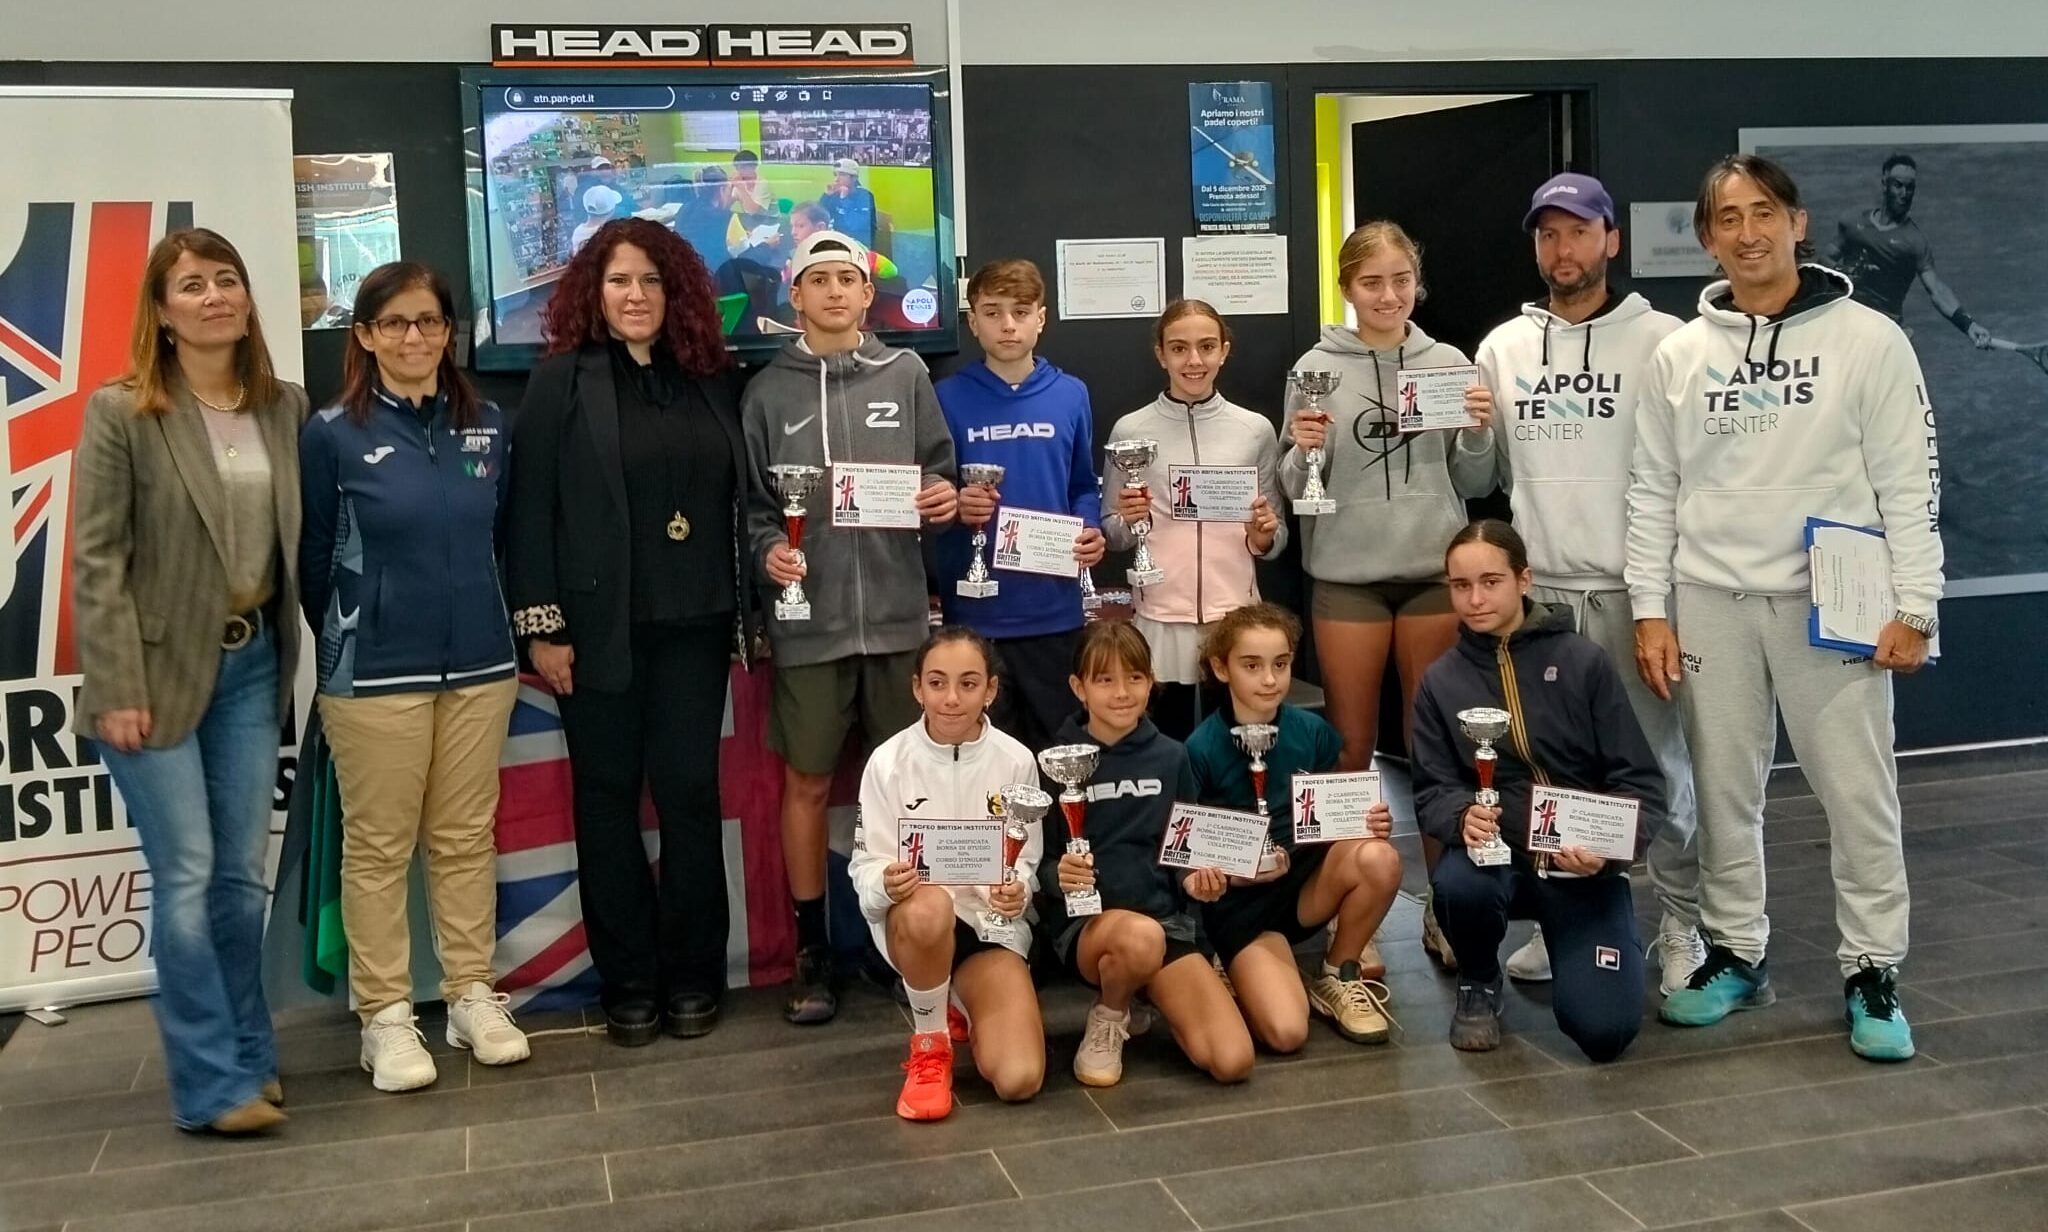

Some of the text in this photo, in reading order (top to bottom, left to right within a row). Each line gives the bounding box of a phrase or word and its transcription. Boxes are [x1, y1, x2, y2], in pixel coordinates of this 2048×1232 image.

[500, 30, 700, 56] HEAD
[717, 30, 907, 56] HEAD
[1201, 109, 1234, 119] Apriamo
[1240, 108, 1264, 117] nostri
[1204, 118, 1258, 126] padel coperti!
[1706, 356, 1819, 386] NAPOLI
[1515, 373, 1621, 395] NAPOLI
[1704, 382, 1814, 412] TENNIS
[1514, 397, 1615, 420] TENNIS
[967, 423, 1055, 443] HEAD
[1514, 423, 1584, 441] CENTER
[1703, 412, 1778, 435] CENTER
[997, 554, 1020, 562] BRITISH
[1543, 791, 1569, 799] TROFEO
[1571, 795, 1596, 804] BRITISH
[1599, 800, 1636, 809] INSTITUTES
[1207, 812, 1231, 820] BRITISH
[1232, 816, 1267, 826] INSTITUTES
[1532, 835, 1560, 844] BRITISH
[1164, 850, 1191, 859] BRITISH
